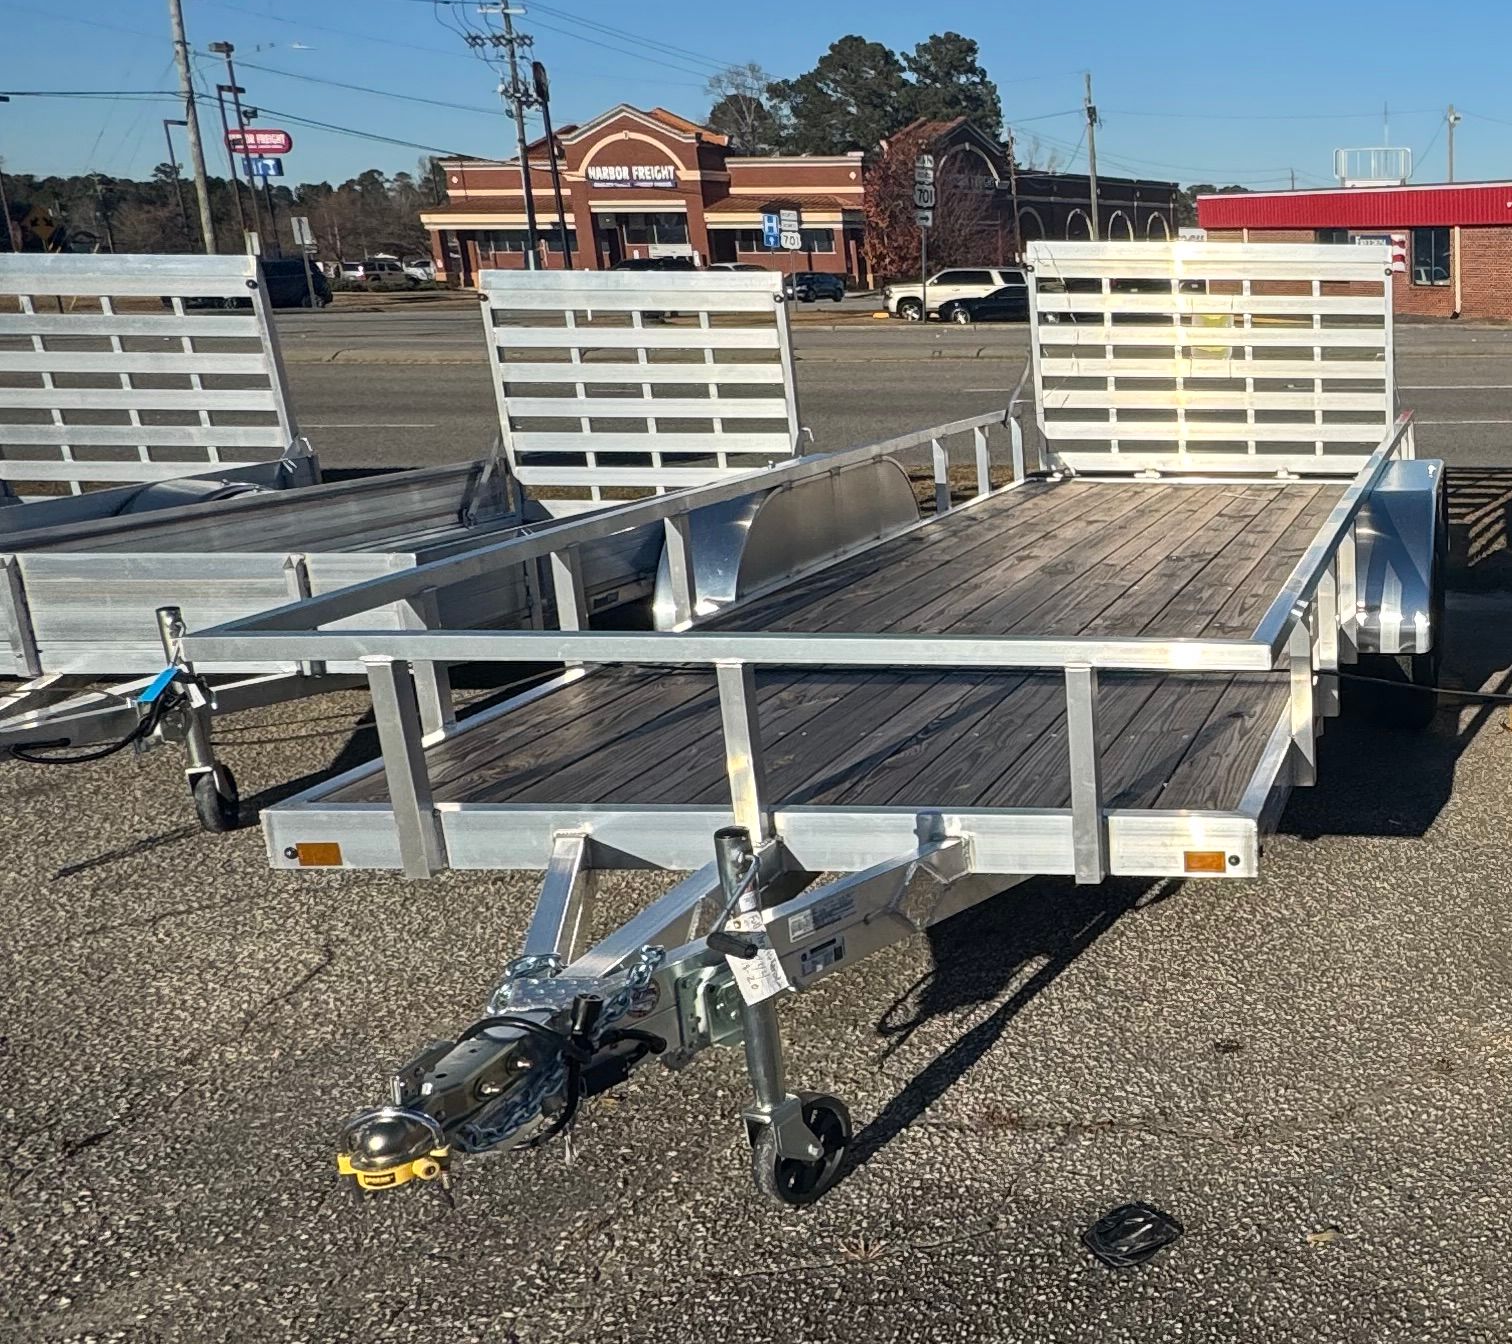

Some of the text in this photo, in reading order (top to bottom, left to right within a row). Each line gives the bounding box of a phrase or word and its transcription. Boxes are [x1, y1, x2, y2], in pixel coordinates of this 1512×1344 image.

[587, 165, 675, 181] HARBOR FREIGHT
[917, 188, 933, 204] 701
[783, 235, 800, 246] 701
